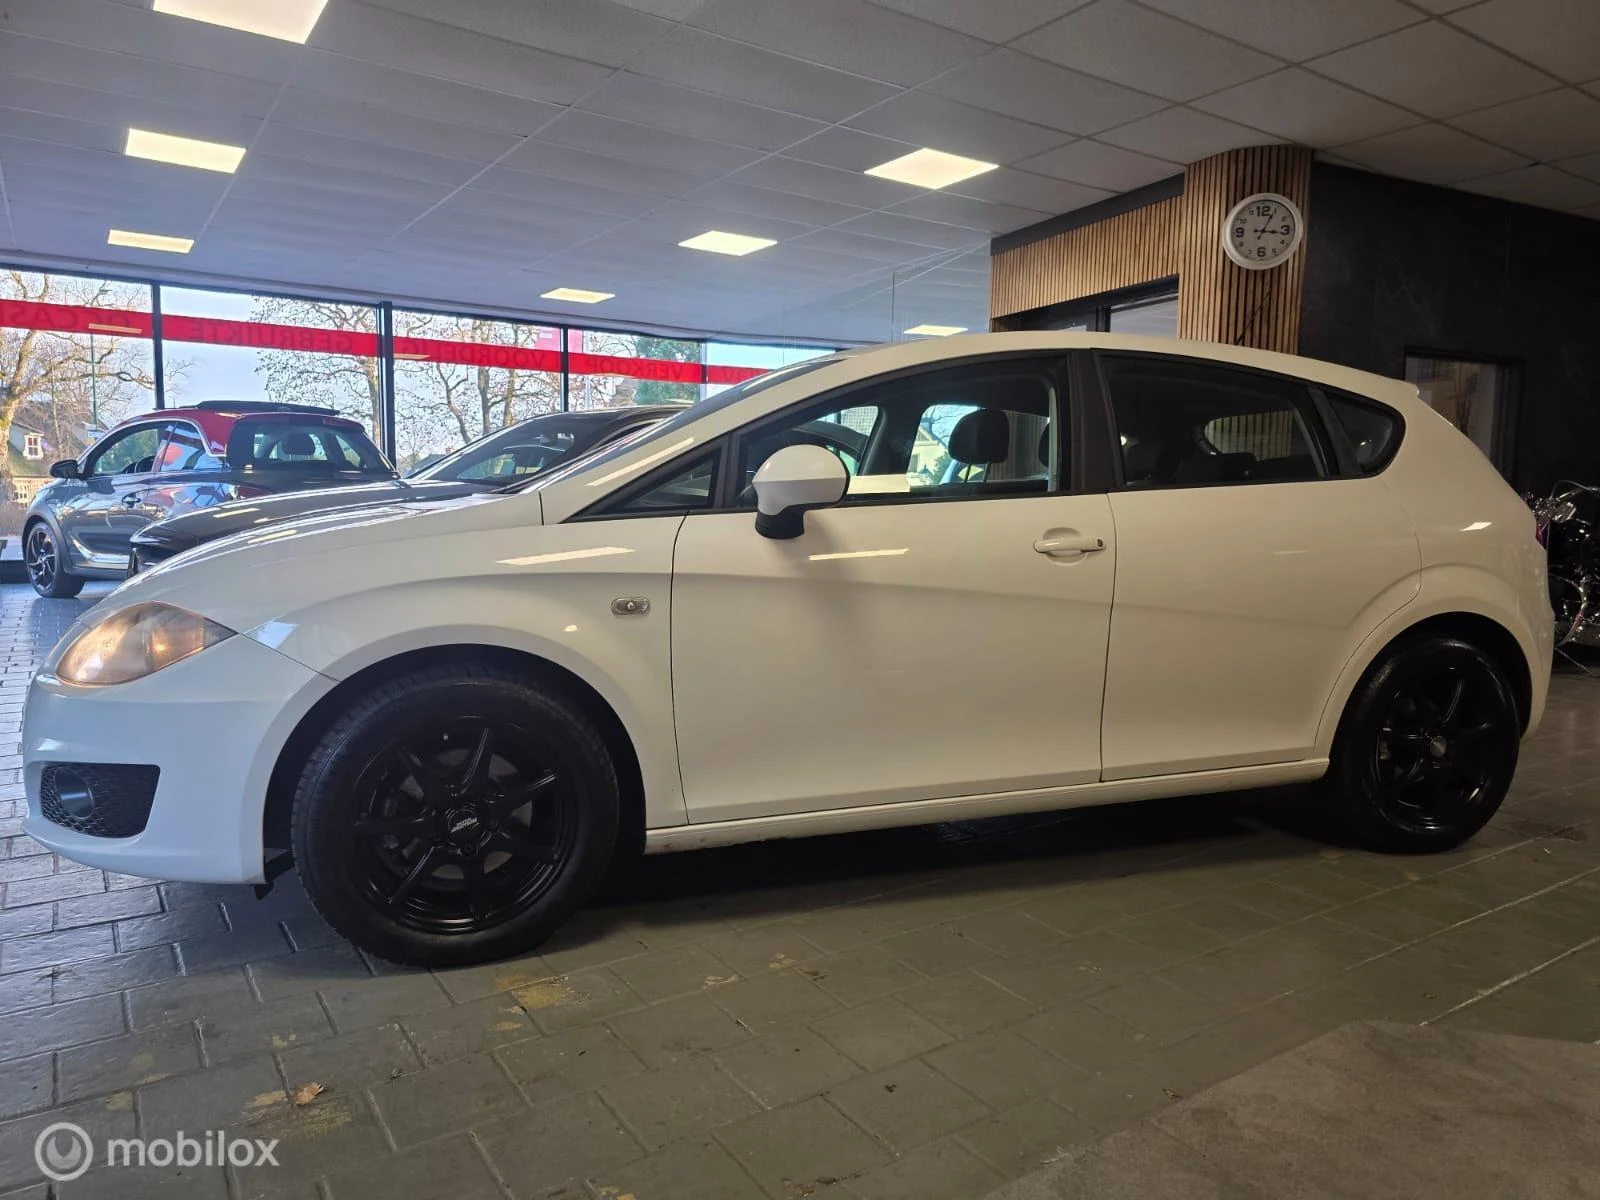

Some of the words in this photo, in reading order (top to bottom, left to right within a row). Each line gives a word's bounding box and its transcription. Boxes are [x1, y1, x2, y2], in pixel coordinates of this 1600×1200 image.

[1256, 205, 1271, 217] 12
[1235, 227, 1245, 238] 9
[1280, 225, 1290, 236] 3
[1257, 247, 1266, 257] 6
